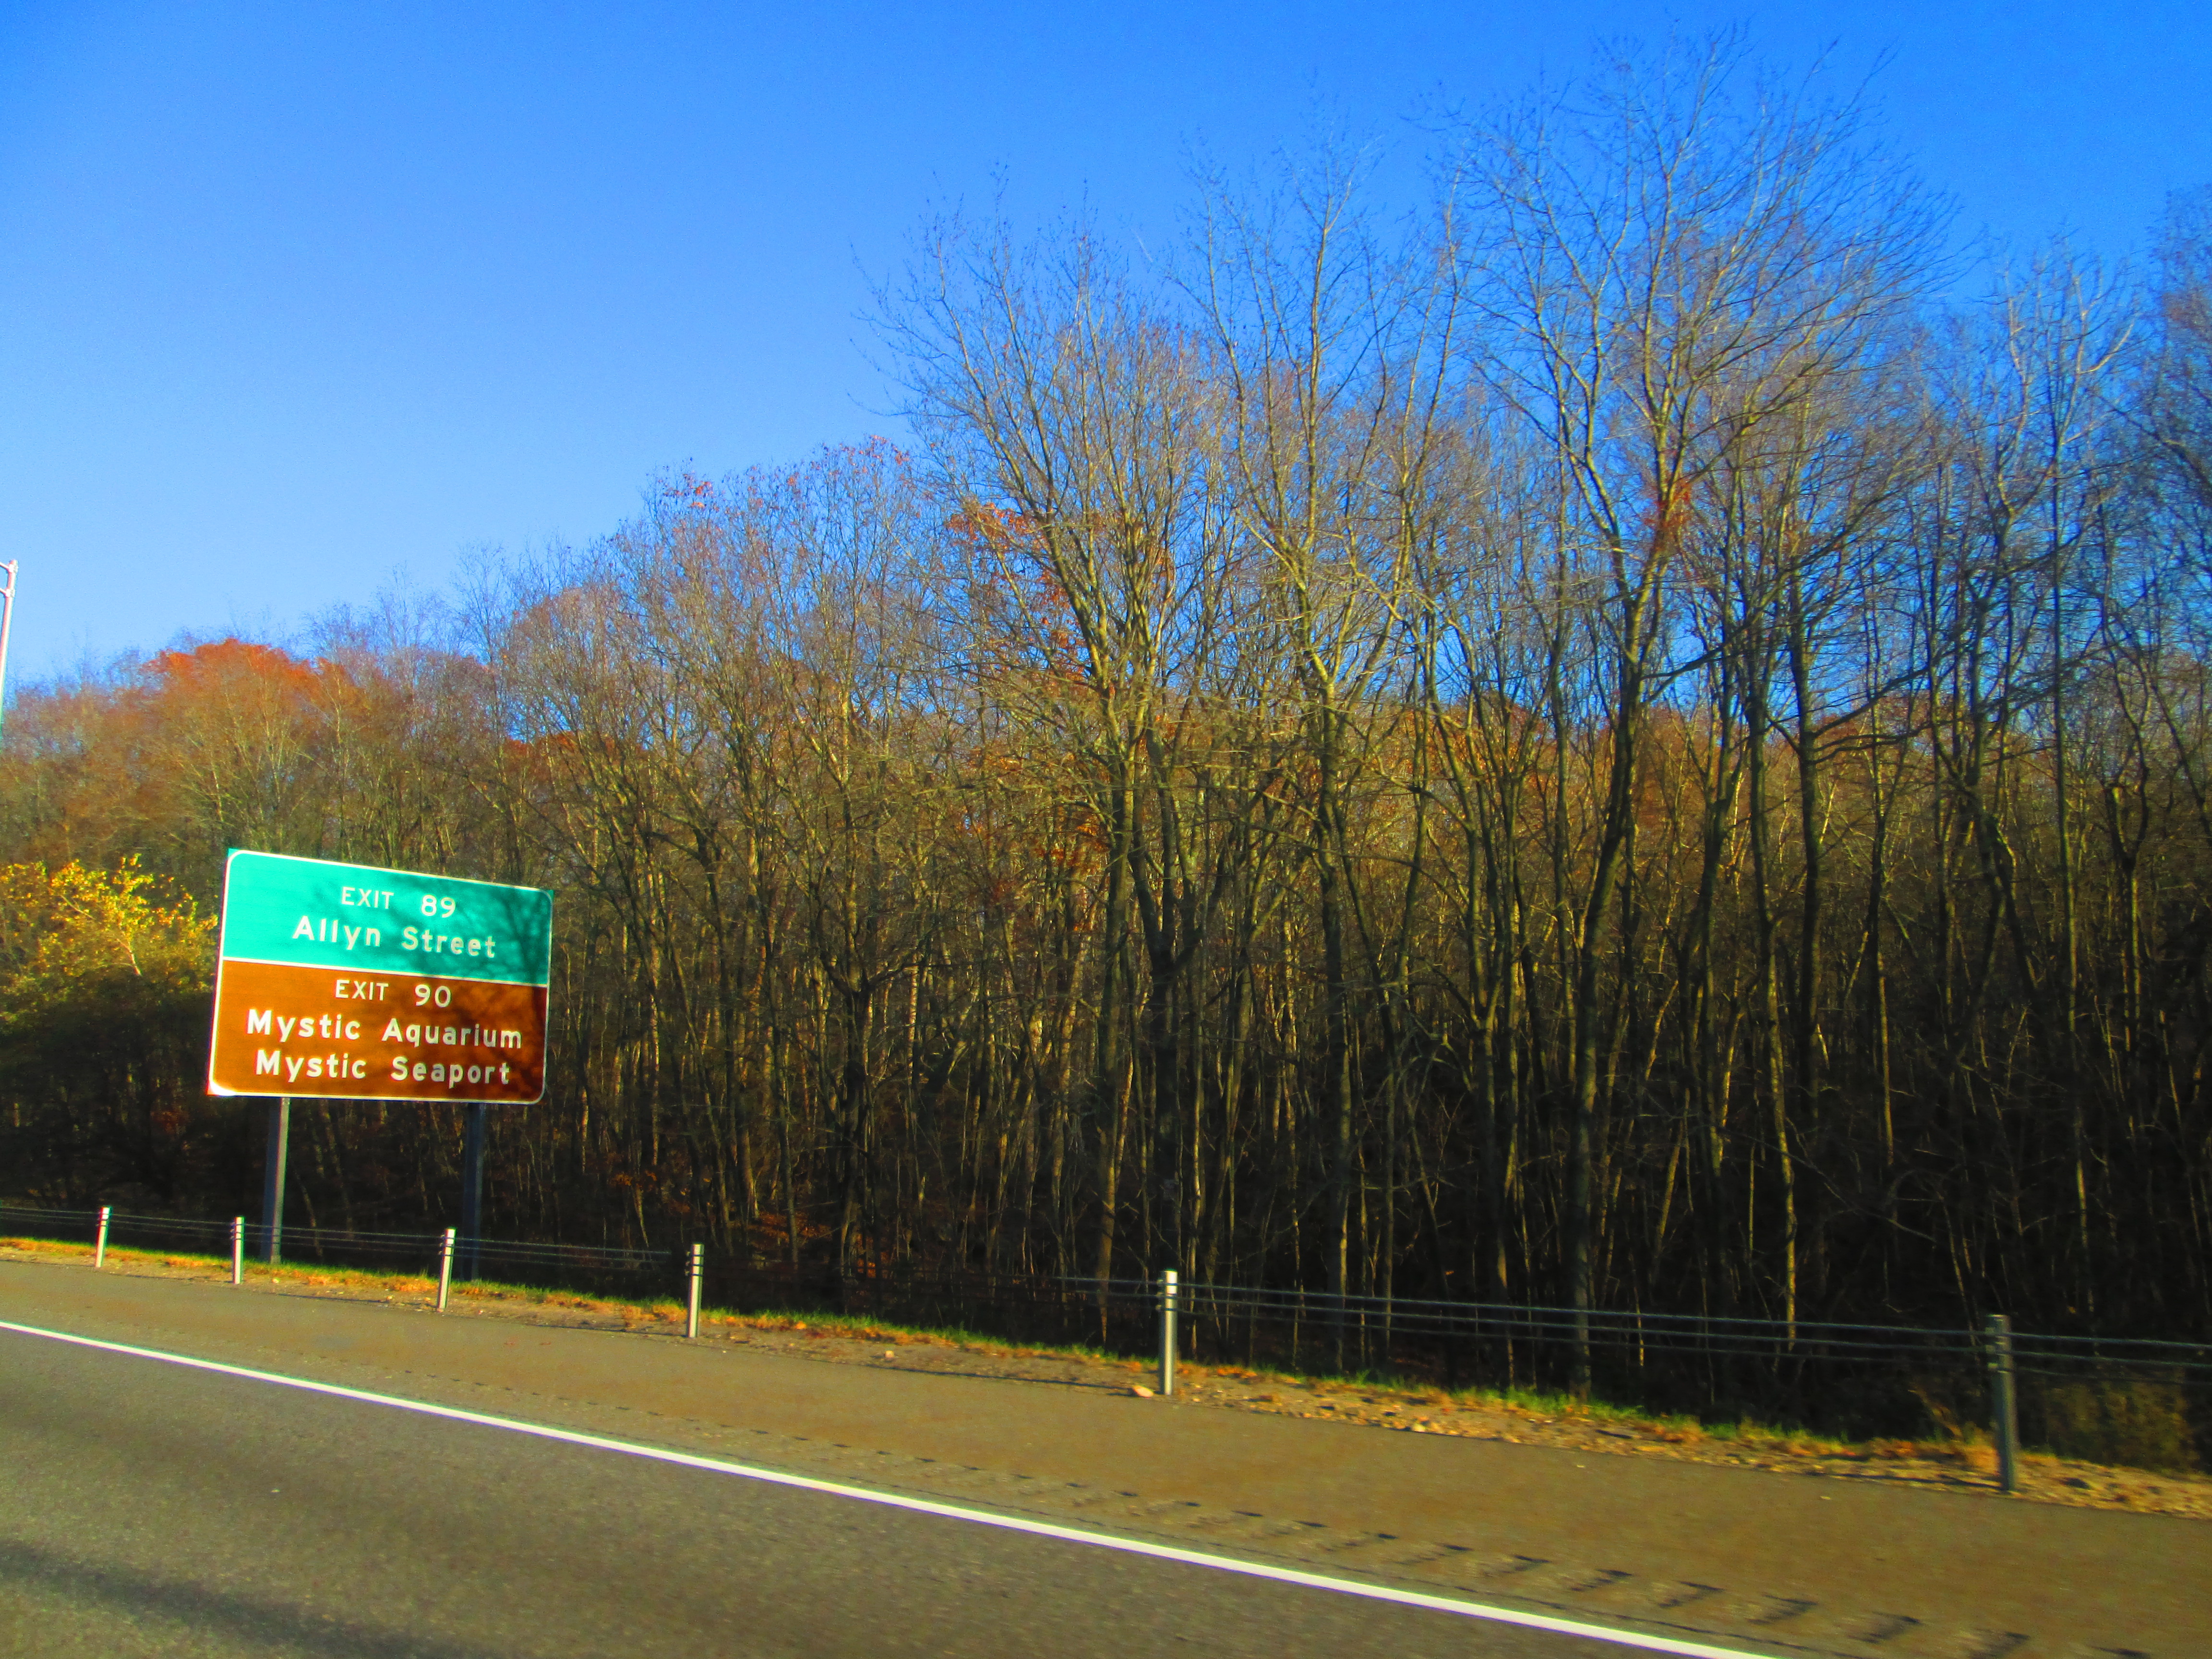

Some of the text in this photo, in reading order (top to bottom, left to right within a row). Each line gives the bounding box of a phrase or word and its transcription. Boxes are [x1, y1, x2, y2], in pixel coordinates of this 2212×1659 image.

[341, 887, 456, 918] EXIT 89
[292, 916, 495, 958] Allyn Street
[335, 979, 451, 1008] EXIT 90
[247, 1009, 522, 1048] Mystic Aquarium
[255, 1049, 511, 1088] Mystic Seaport
